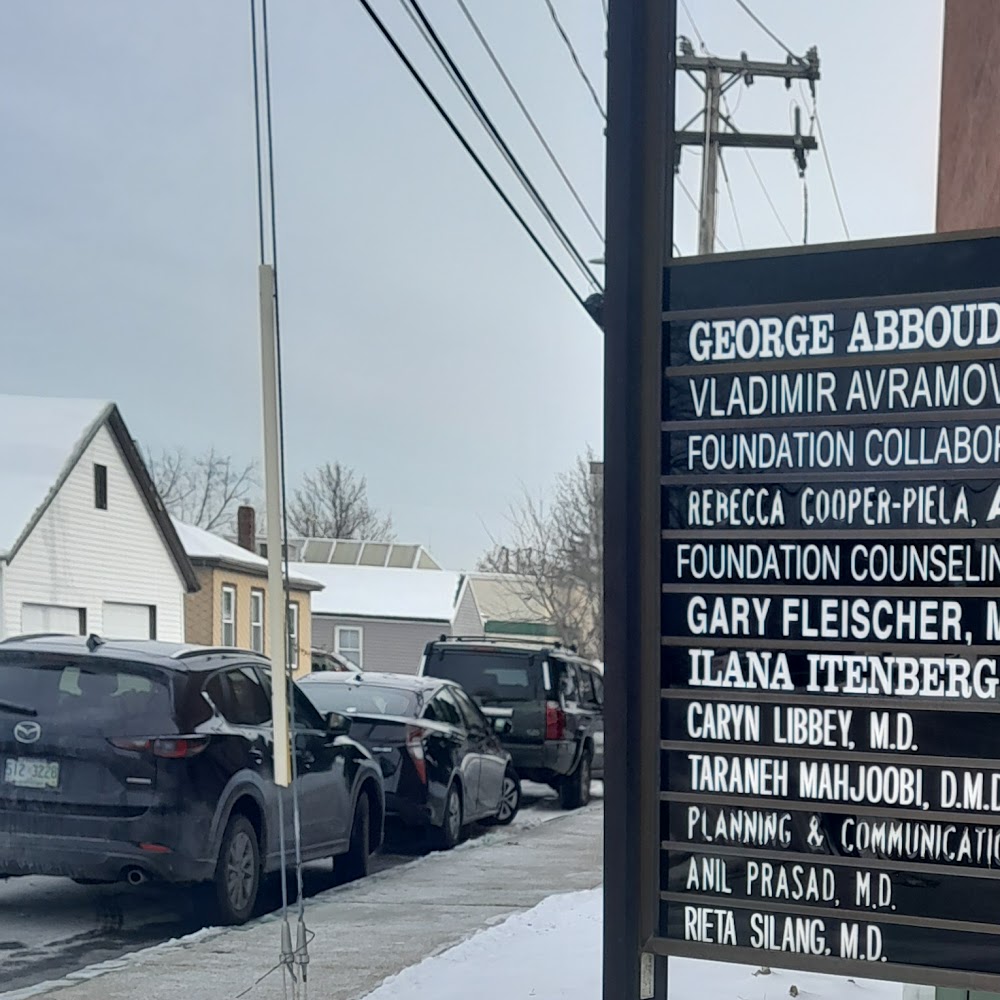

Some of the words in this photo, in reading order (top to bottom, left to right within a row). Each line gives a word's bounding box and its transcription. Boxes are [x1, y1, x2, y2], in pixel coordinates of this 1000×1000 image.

[689, 313, 834, 362] GEORGE
[689, 372, 837, 417] VLADIMIR
[688, 430, 854, 470] FOUNDATION
[688, 488, 785, 526] REBECCA
[801, 485, 977, 527] COOPER-PIELA,
[677, 543, 840, 581] FOUNDATION
[687, 595, 771, 636] GARY
[782, 598, 972, 646] FLEISCHER,
[688, 648, 795, 691] ILANA
[687, 701, 760, 742] CARYN
[774, 706, 856, 750] LIBBEY,
[870, 711, 918, 751] M.D.
[687, 754, 788, 797] TARANEH
[799, 761, 930, 811] MAHJOOBI,
[688, 805, 792, 845] PLANNING
[807, 815, 824, 847] &
[686, 856, 732, 894] ANIL
[747, 861, 840, 907] PRASAD,
[855, 871, 896, 910] M.D.
[684, 905, 737, 946] RIETA
[750, 912, 831, 956] SILANG,
[840, 922, 887, 963] M.D.
